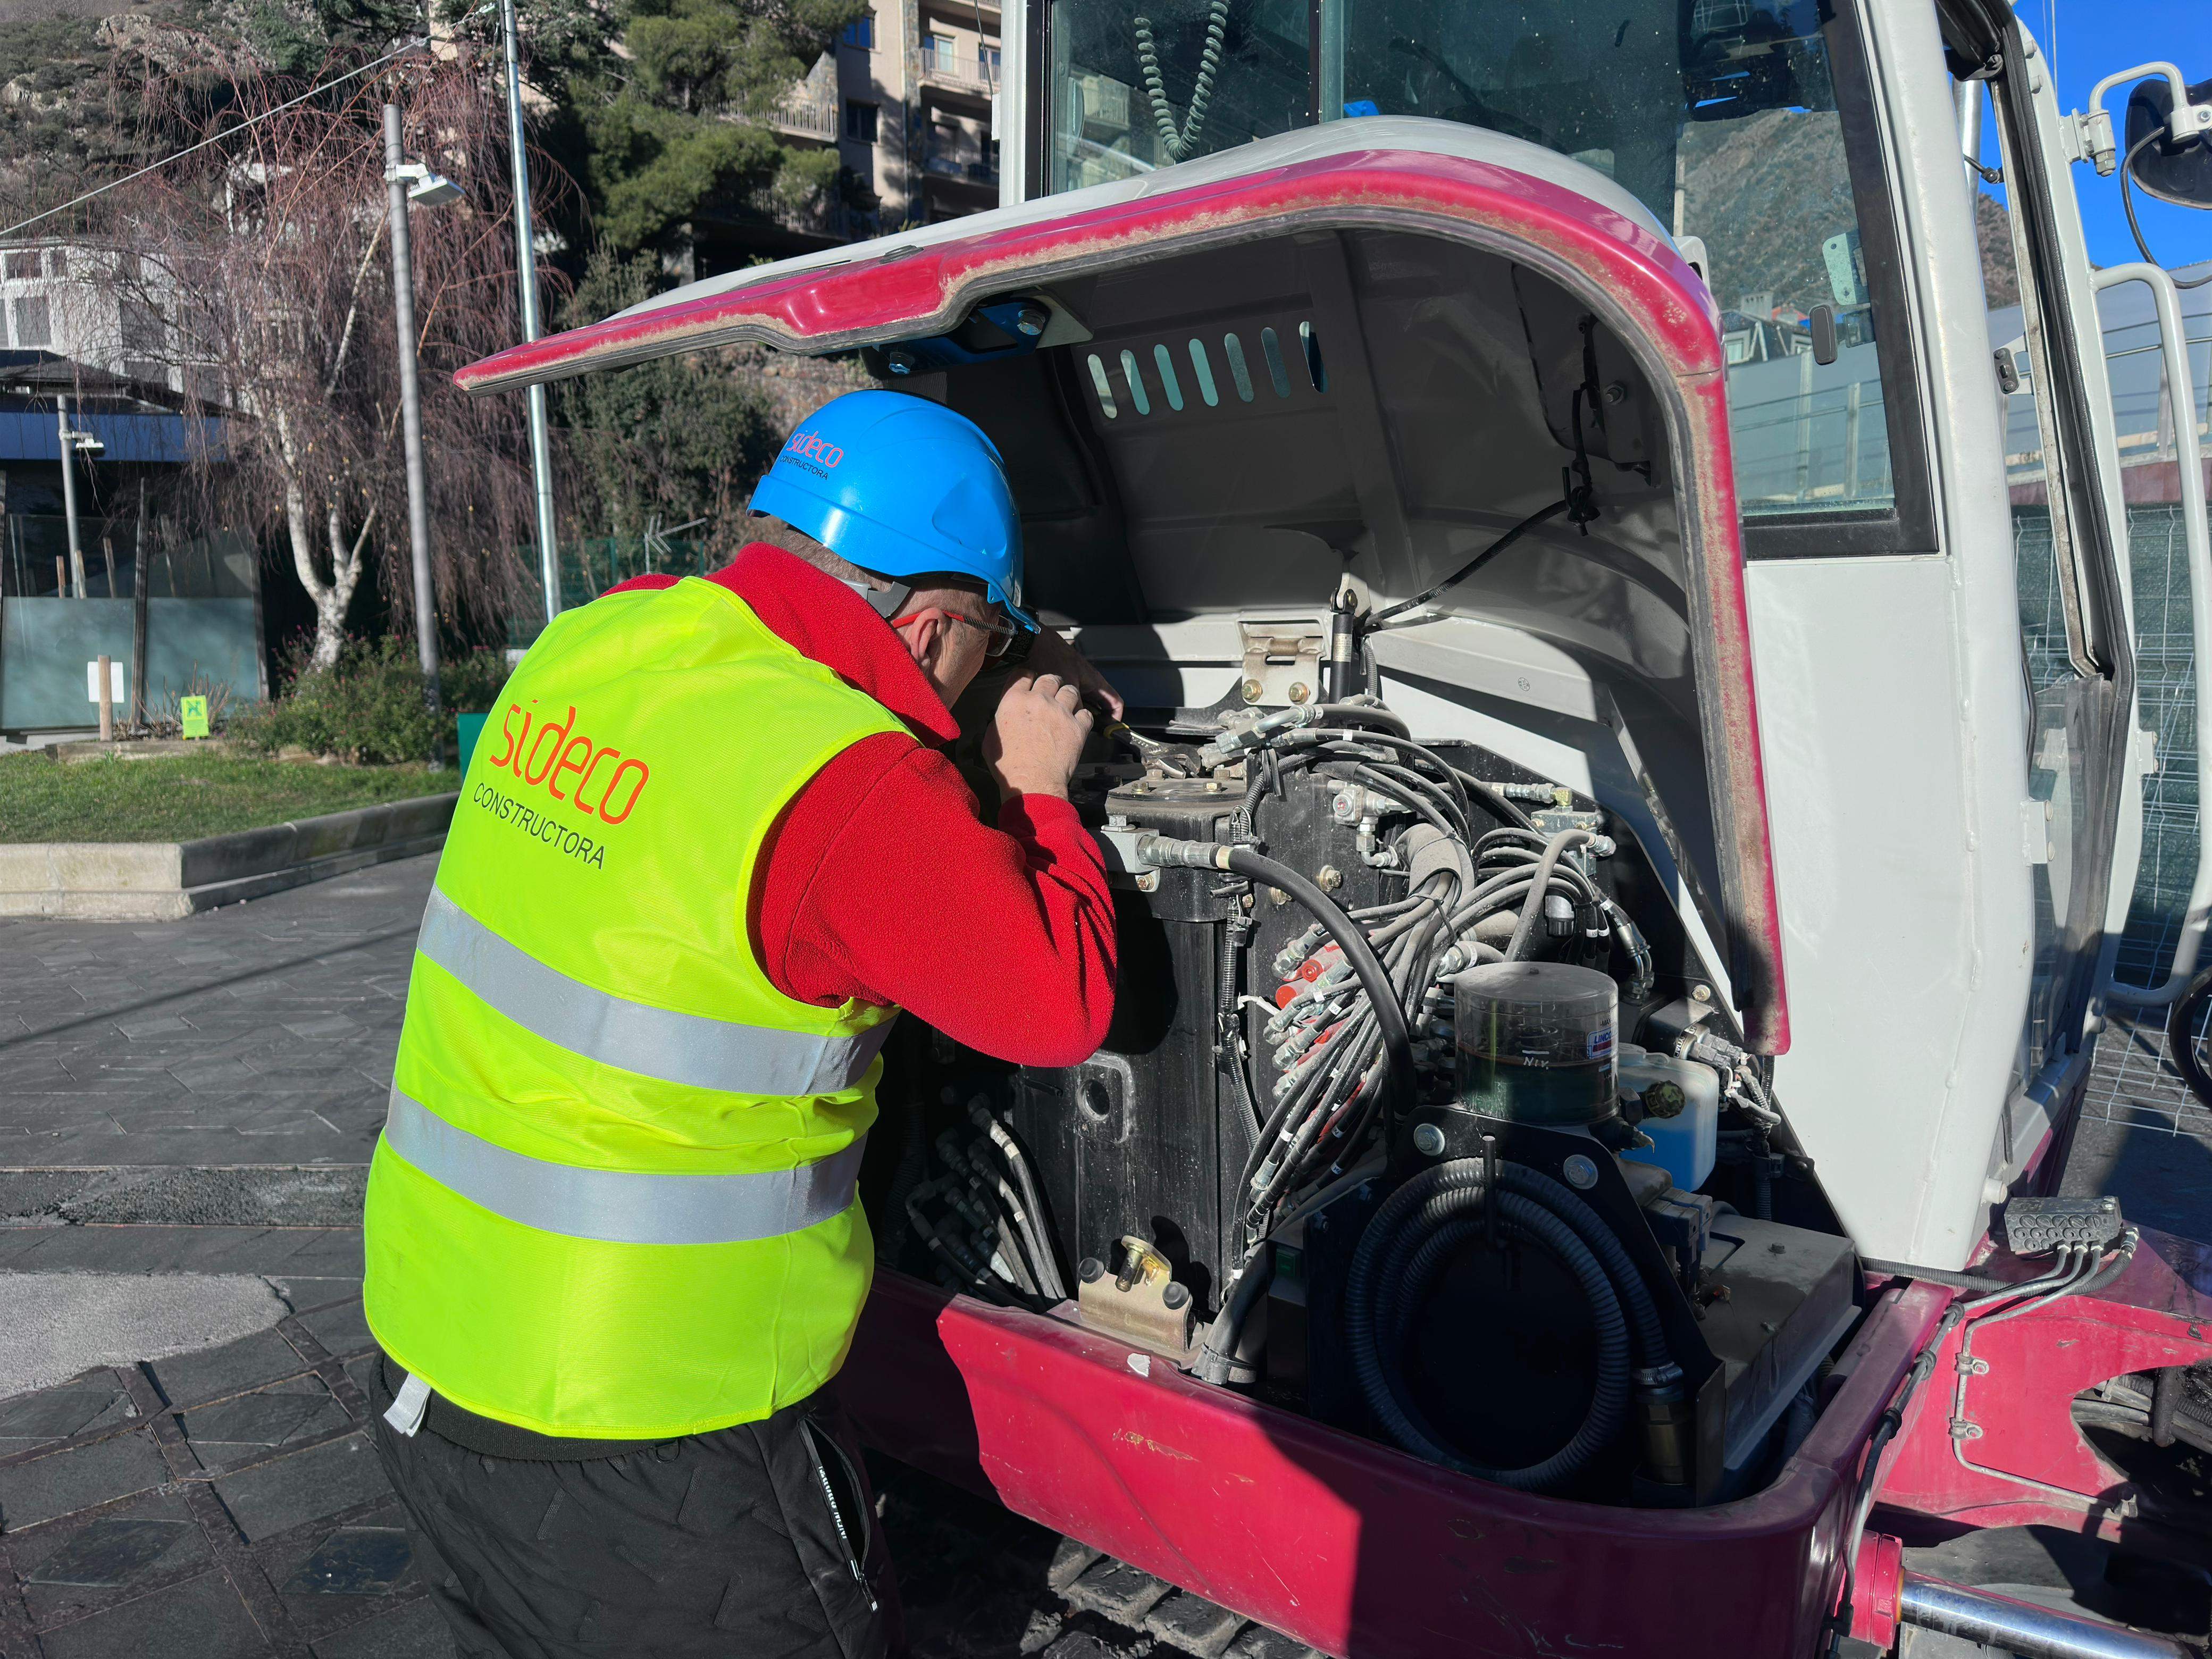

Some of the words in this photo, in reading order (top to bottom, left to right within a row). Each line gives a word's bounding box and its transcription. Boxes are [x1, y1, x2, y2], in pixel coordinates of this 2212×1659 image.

[780, 455, 829, 481] CONSTRUCTORA
[786, 430, 844, 468] sideco
[489, 699, 649, 825] sideco
[473, 783, 605, 870] CONSTRUCTORA
[1594, 1031, 1613, 1044] LINCO
